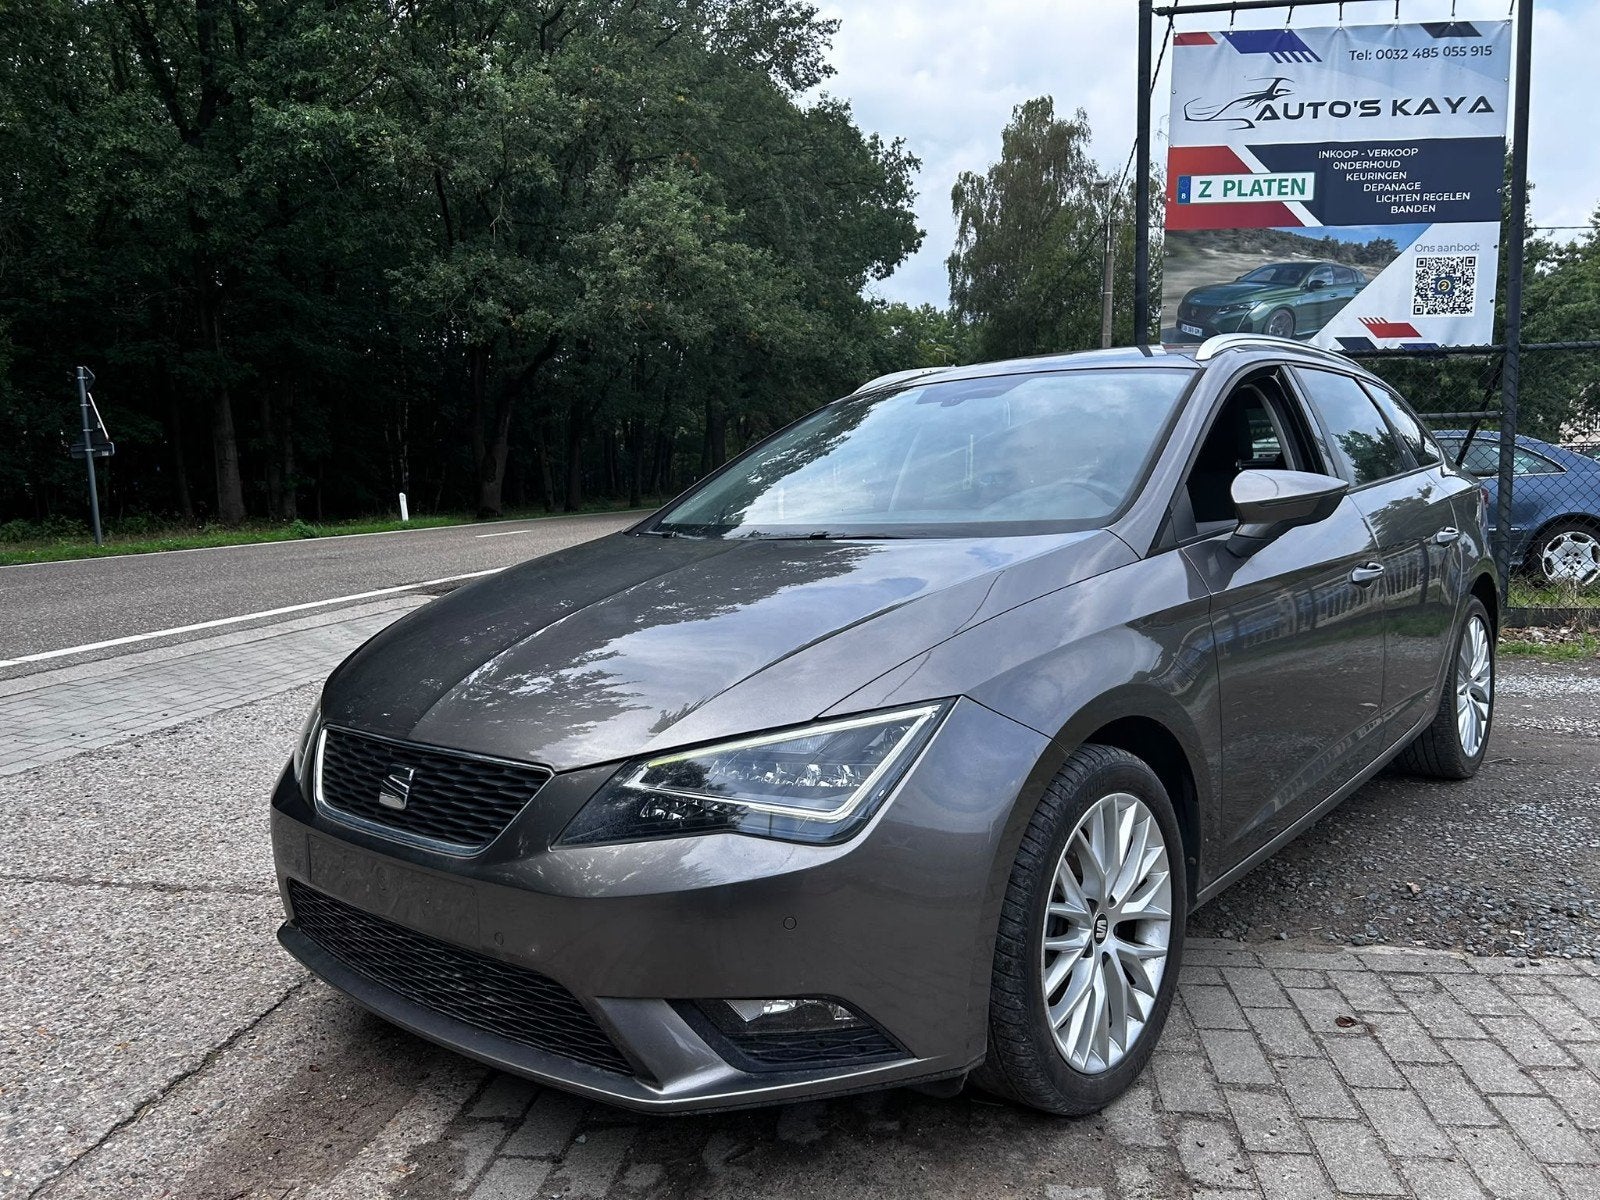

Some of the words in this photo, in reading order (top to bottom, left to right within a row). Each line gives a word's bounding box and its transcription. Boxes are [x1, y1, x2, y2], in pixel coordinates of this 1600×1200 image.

[1348, 49, 1372, 61] Tel:
[1375, 48, 1409, 60] 0032
[1412, 47, 1439, 59] 485
[1442, 45, 1467, 57] 055
[1470, 45, 1493, 57] 915
[1254, 99, 1382, 122] AUTO'S
[1391, 95, 1495, 117] KAYA
[1318, 149, 1359, 159] INKOOP
[1367, 147, 1419, 158] VERKOOP
[1332, 160, 1401, 170] ONDERHOUD
[1345, 171, 1407, 181] KEURINGEN
[1198, 180, 1213, 198] Z
[1222, 177, 1306, 198] PLATEN
[1363, 181, 1422, 192] DEPANAGE
[1375, 193, 1421, 203] LICHTEN
[1422, 191, 1471, 202] REGELEN
[1390, 204, 1436, 214] BANDEN
[1414, 243, 1436, 253] Ons
[1437, 242, 1480, 252] aanbod:
